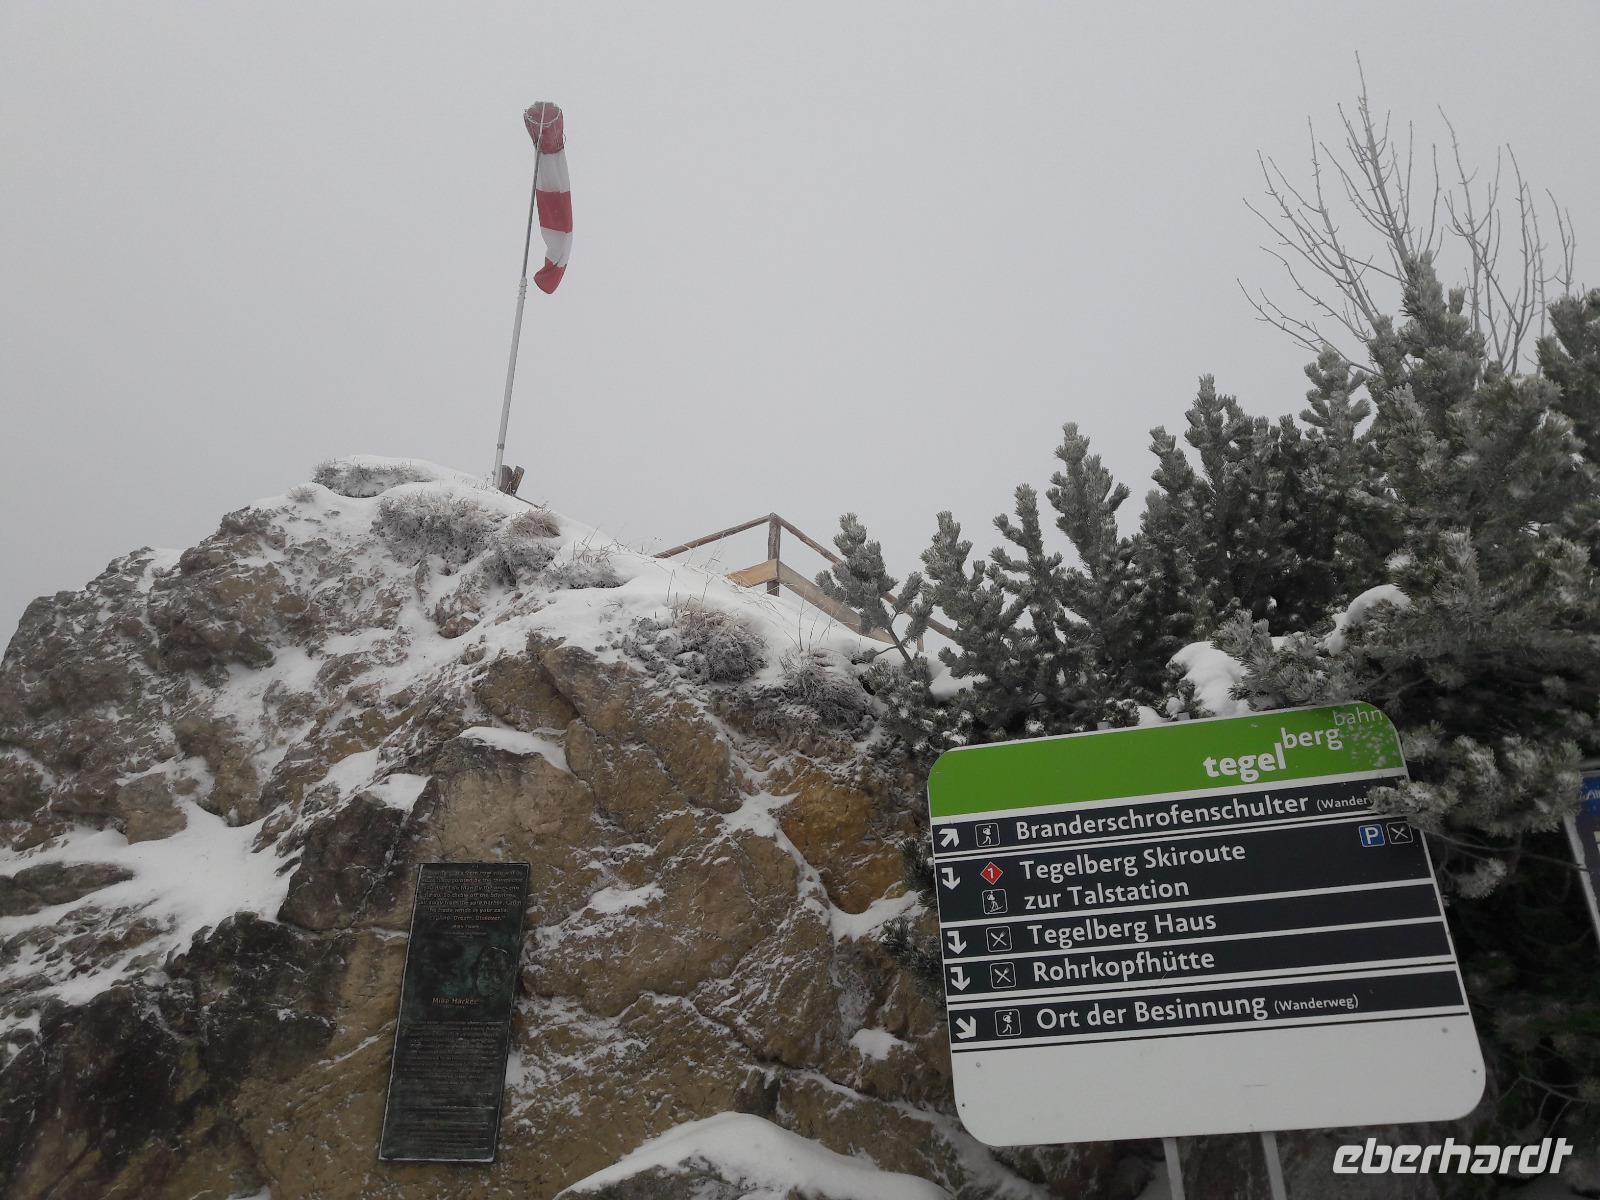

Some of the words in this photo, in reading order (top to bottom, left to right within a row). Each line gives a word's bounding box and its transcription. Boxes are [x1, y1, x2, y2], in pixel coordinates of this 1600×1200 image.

[1332, 706, 1384, 726] bahn
[1015, 794, 1309, 841] Branderschrofenschulter
[1019, 853, 1139, 884] Tegelberg
[1143, 845, 1246, 869] Skiroute
[1024, 894, 1062, 910] zur
[1066, 879, 1190, 906] Talstation
[1027, 918, 1149, 949] Tegelberg
[1155, 913, 1217, 934] Haus
[1033, 950, 1215, 983] Rohrkopfhütte
[1036, 1009, 1081, 1030] Ort
[1086, 1002, 1127, 1026] der
[1134, 998, 1268, 1023] Besinnung
[1274, 994, 1359, 1015] (Wanderweg)
